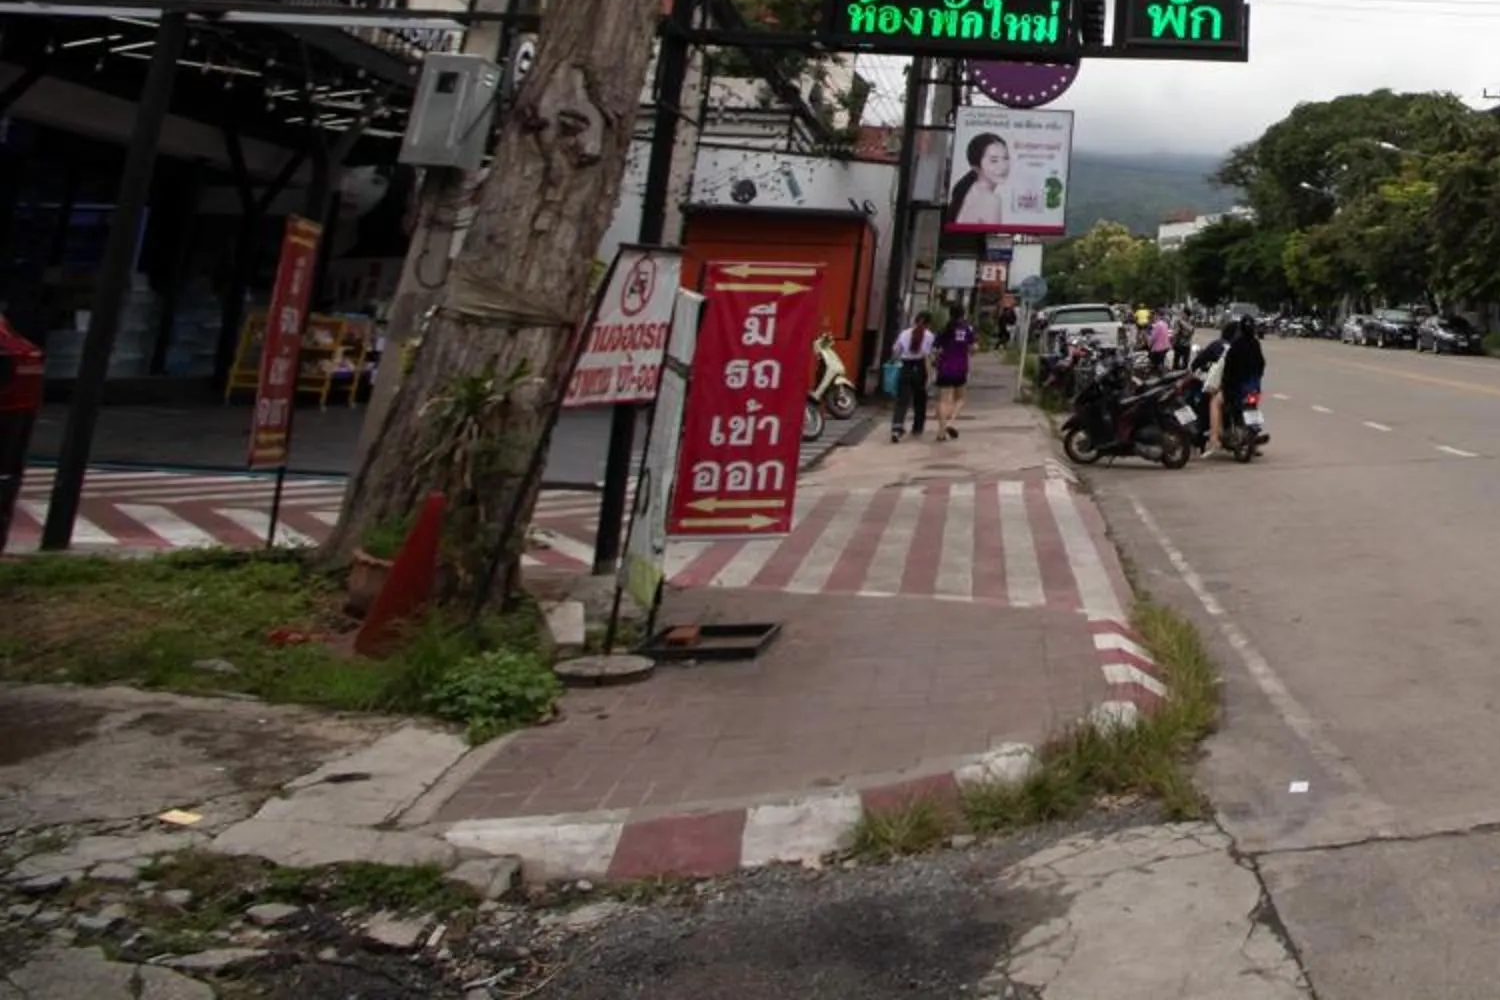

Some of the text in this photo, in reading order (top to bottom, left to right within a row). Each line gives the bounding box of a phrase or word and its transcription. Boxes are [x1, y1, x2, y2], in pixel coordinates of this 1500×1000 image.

[741, 302, 777, 345] มี
[725, 359, 781, 389] รถ
[709, 399, 780, 445] เข้า
[692, 460, 784, 491] ออก
